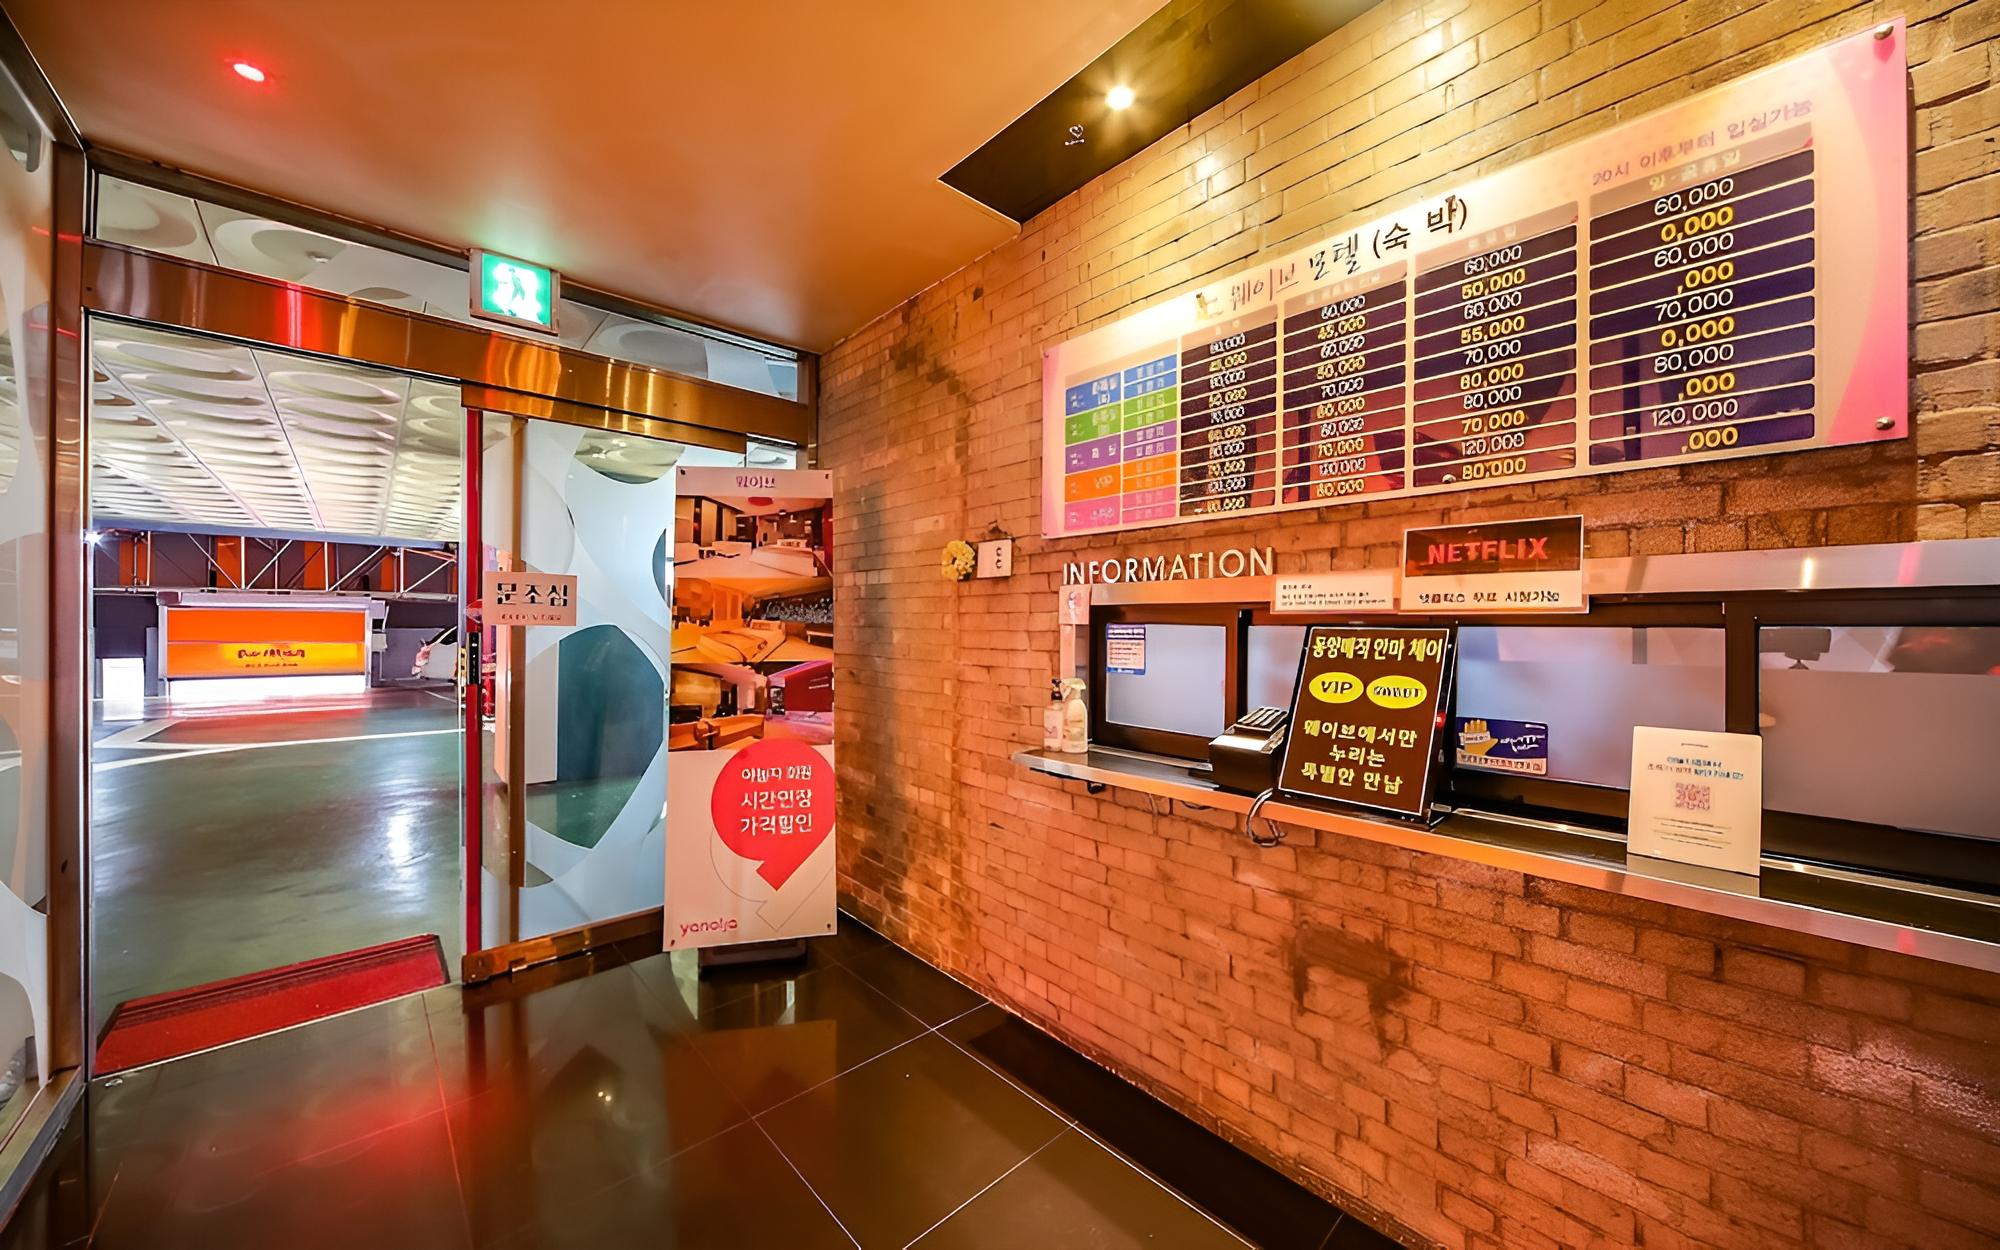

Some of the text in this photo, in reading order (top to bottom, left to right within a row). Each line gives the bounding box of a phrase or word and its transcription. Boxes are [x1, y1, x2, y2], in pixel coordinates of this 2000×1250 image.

[1592, 161, 1629, 186] 20시
[1654, 178, 1733, 215] 60,000
[1654, 232, 1733, 267] 60,000
[1462, 268, 1525, 299] 50,000
[1655, 289, 1733, 321] 70,000
[1463, 340, 1521, 365] 70,000
[1654, 343, 1734, 373] 80,000
[1462, 410, 1525, 434] 70,000
[1652, 398, 1738, 426] 120,000
[1427, 537, 1548, 565] NETFLIX
[1063, 546, 1273, 585] INFORMATION
[497, 583, 568, 607] 문조심
[1321, 680, 1353, 694] VIP
[1329, 744, 1386, 768] 누리는
[1363, 771, 1403, 795] 만남
[680, 917, 738, 936] yanolja
